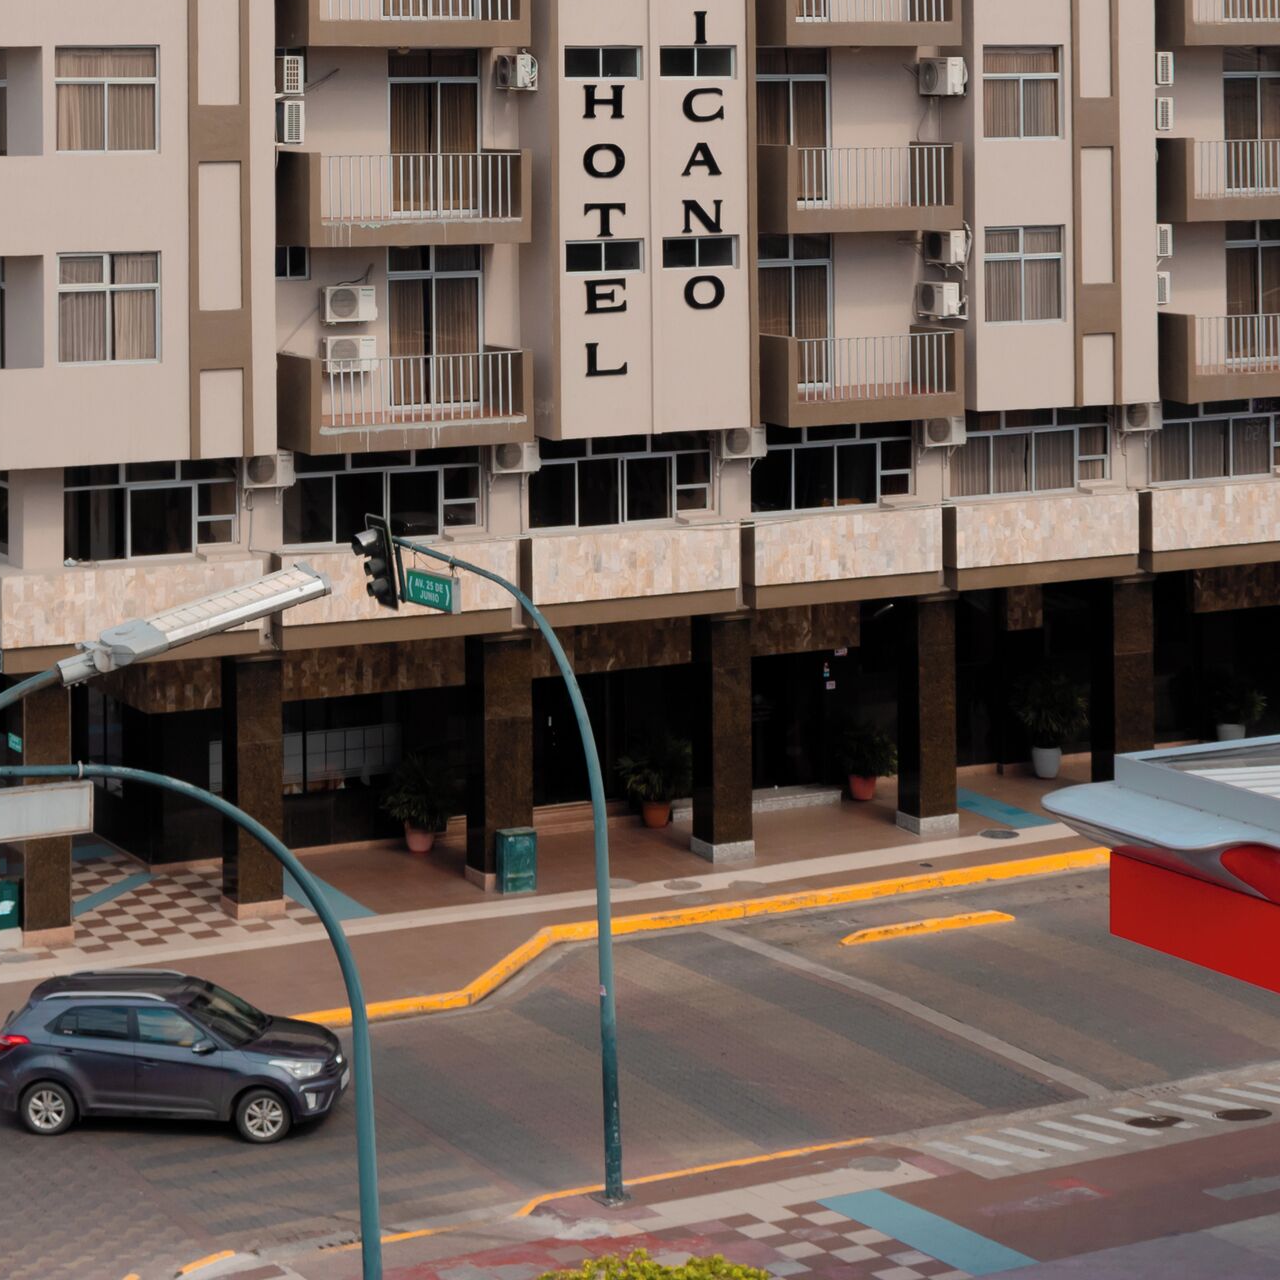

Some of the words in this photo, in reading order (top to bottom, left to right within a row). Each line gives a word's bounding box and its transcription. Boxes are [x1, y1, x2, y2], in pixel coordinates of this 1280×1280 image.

[582, 84, 627, 377] HOTEL
[434, 582, 444, 593] DE
[419, 590, 440, 603] JUNIO
